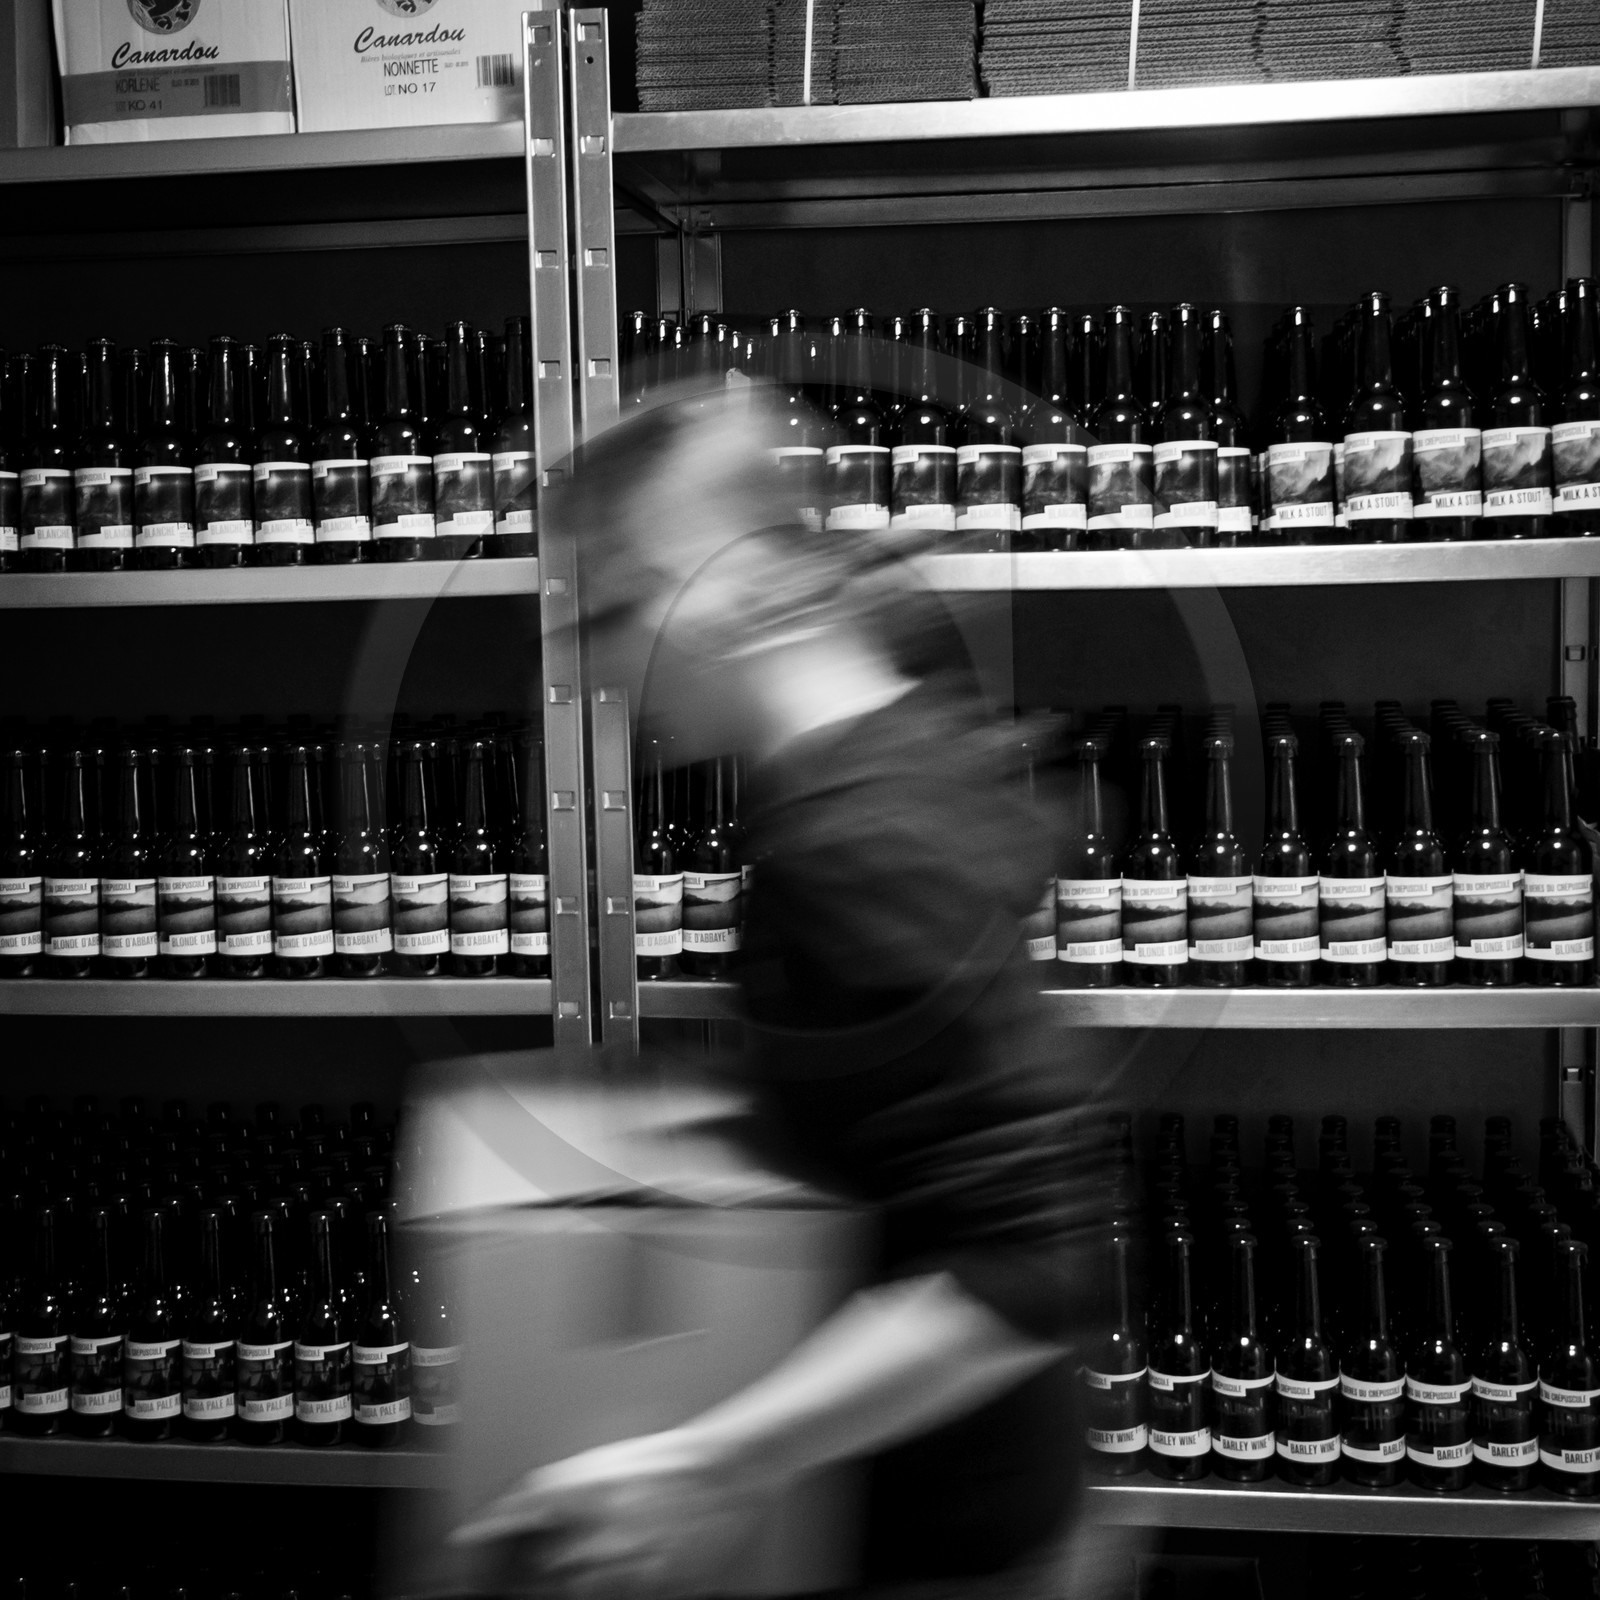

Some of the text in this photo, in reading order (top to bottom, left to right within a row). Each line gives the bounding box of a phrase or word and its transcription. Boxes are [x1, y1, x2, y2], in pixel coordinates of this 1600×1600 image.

[354, 23, 466, 53] Canardou
[111, 40, 219, 69] Canardou
[384, 58, 439, 77] NONNETTE
[115, 77, 160, 93] KORLENE
[398, 83, 418, 94] NO
[423, 82, 436, 93] 17
[128, 100, 146, 111] KO
[150, 100, 163, 110] 41
[1490, 496, 1504, 507] MILK
[1509, 494, 1514, 504] A
[1517, 492, 1541, 503] STOUT
[1563, 488, 1580, 501] MILK
[1584, 488, 1590, 498] A
[1350, 495, 1400, 512] MILK A STOUT
[1435, 497, 1454, 508] MILK
[1458, 496, 1463, 505] A
[1278, 506, 1328, 520] MILK A STOUT
[37, 527, 70, 540] BLANCHE
[210, 524, 242, 536] BLANCHE
[171, 936, 198, 947] BLONDE
[228, 936, 253, 948] BLONDE
[694, 931, 727, 943] D'ABBAYE
[53, 938, 78, 950] BLONDE
[1198, 943, 1225, 954] BLONDE
[1263, 943, 1289, 954] BLONDE
[1331, 944, 1358, 956] BLONDE
[1394, 944, 1420, 955] BLONDE
[1475, 942, 1502, 953] BLONDE
[1555, 944, 1581, 955] BLONDE
[1069, 946, 1097, 957] BLONDE
[1138, 946, 1165, 957] BLONDE
[45, 1392, 63, 1405] PALE
[89, 1394, 105, 1406] PALE
[157, 1399, 173, 1411] PALE
[206, 1399, 223, 1411] PALE
[266, 1400, 283, 1412] PALE
[316, 1401, 332, 1413] PALE
[380, 1404, 396, 1416] PALE
[1116, 1431, 1134, 1443] WINE
[1153, 1433, 1176, 1446] BARLEY
[1178, 1433, 1196, 1446] WINE
[1222, 1437, 1267, 1451] BARLEY WINE
[1289, 1442, 1335, 1455] BARLEY WINE
[1436, 1448, 1463, 1461] BARLEY
[1491, 1444, 1520, 1457] BARLEY
[1564, 1452, 1593, 1464] BARLEY
